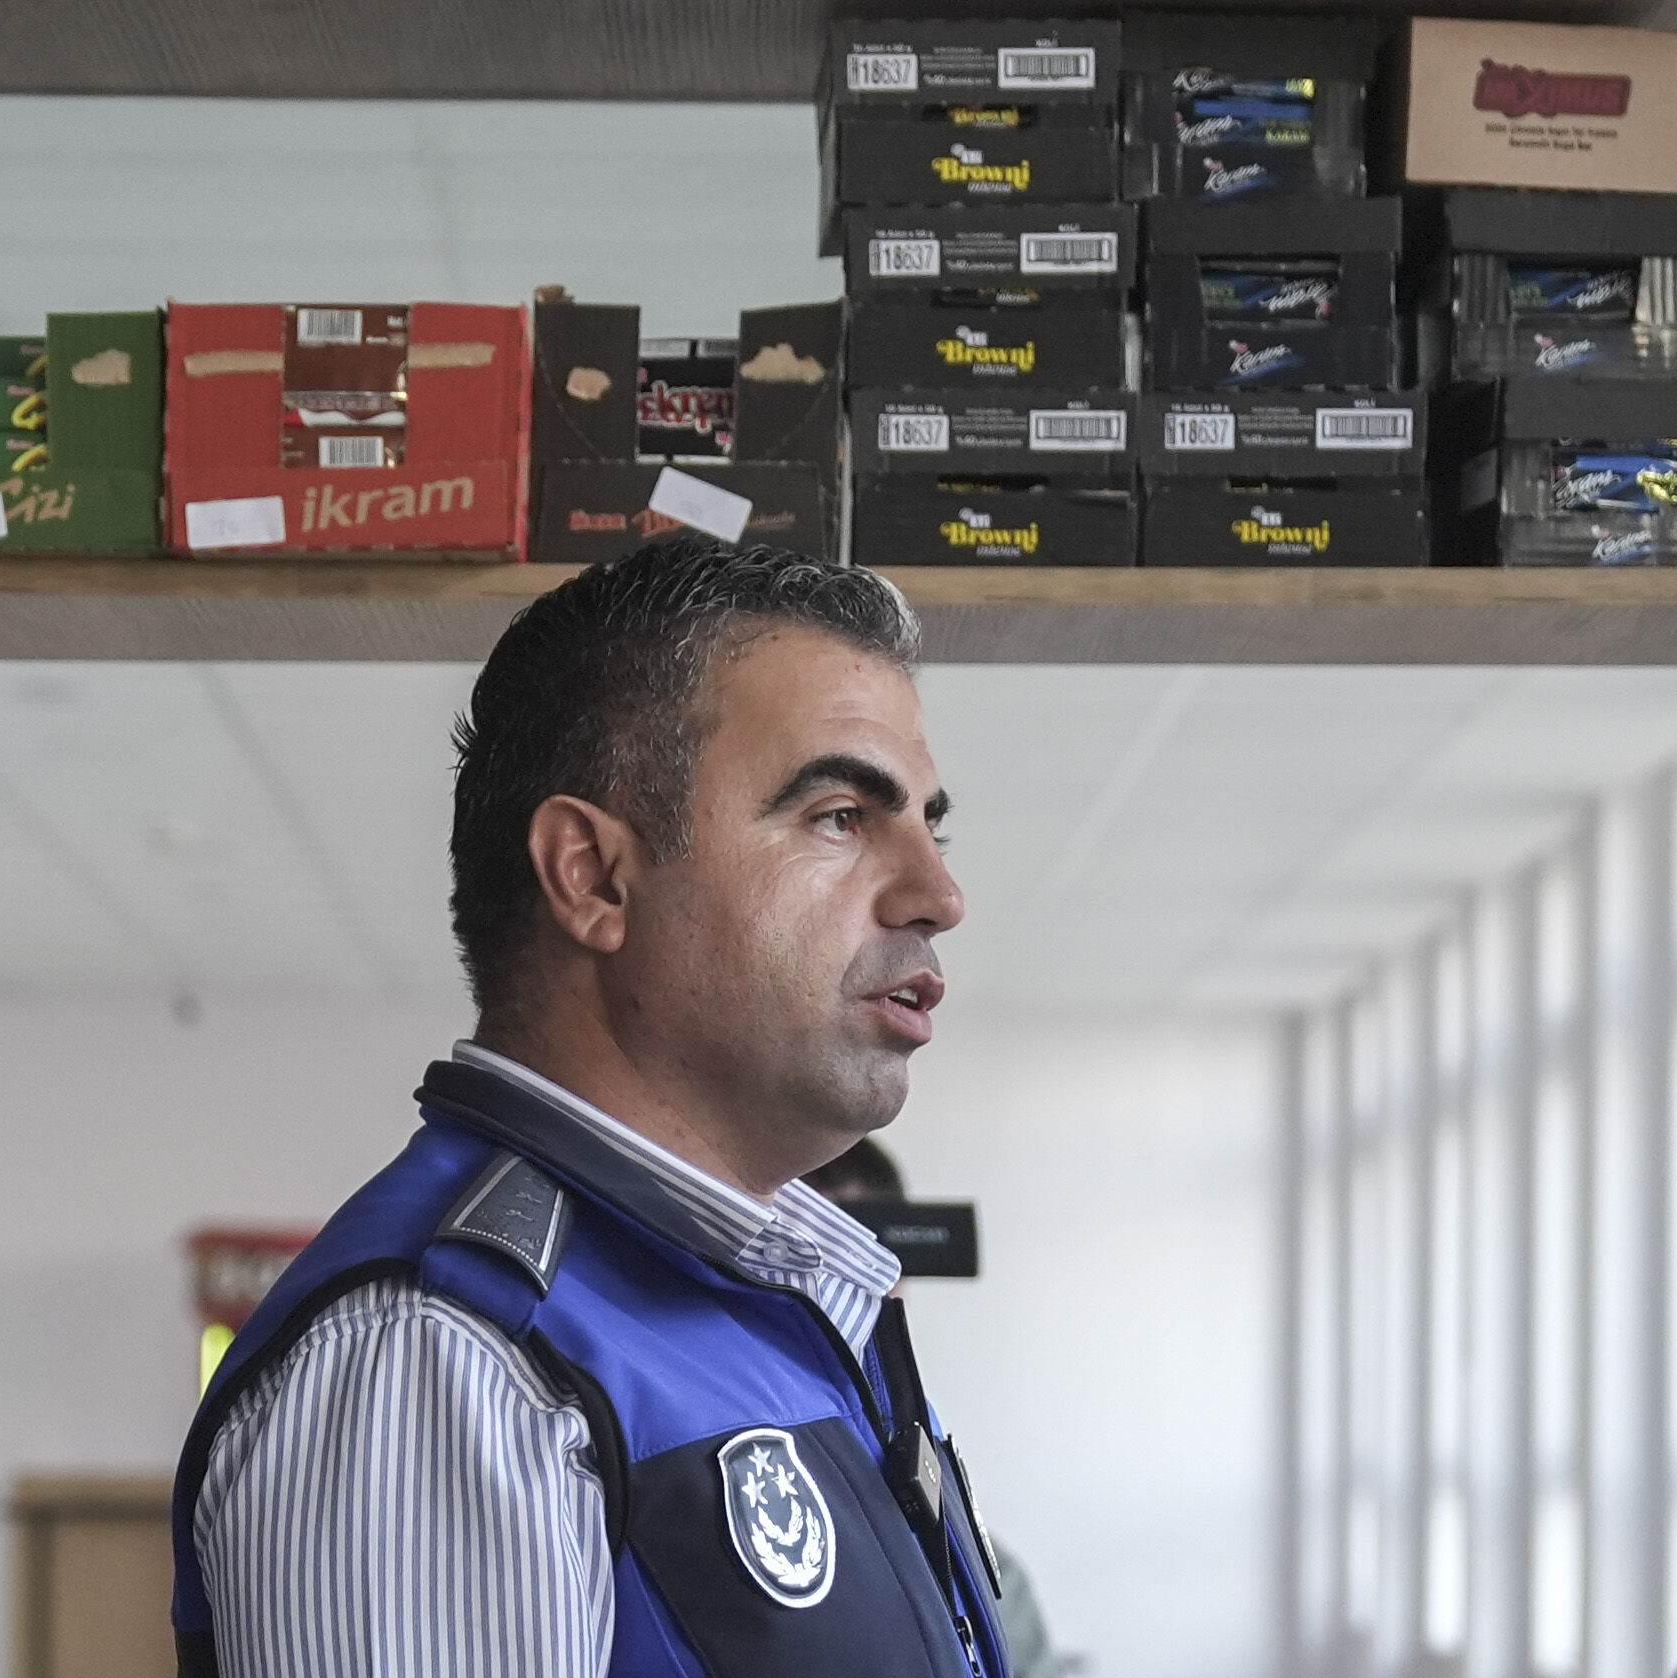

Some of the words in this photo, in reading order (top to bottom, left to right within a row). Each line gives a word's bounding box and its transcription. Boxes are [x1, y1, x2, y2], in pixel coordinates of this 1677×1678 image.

[931, 156, 1031, 191] Browni
[935, 338, 1036, 373] Browni
[301, 476, 475, 533] ikram
[939, 521, 1040, 554] Browni
[1231, 519, 1331, 552] Browni
